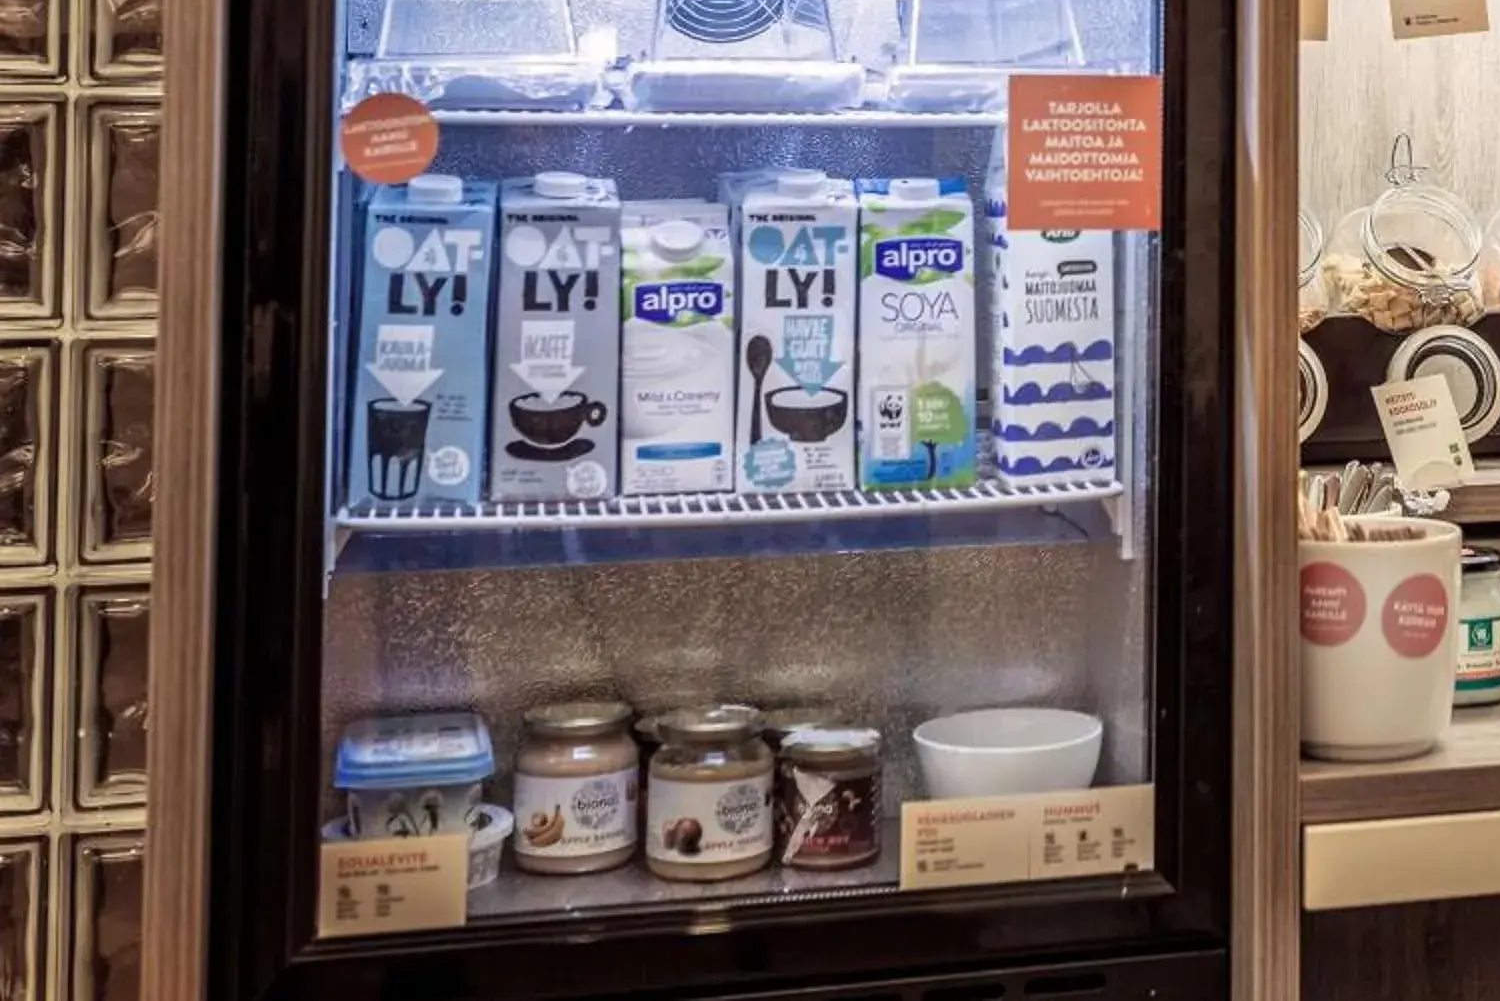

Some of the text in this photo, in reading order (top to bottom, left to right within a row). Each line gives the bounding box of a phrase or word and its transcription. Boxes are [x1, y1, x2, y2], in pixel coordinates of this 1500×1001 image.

[1048, 102, 1123, 116] TARJOLLA
[1021, 118, 1147, 132] LAKTOOSITONTA
[1044, 135, 1125, 149] MAITOA JA
[1028, 152, 1140, 166] MAIDOTTOMIA
[881, 242, 957, 274] alpro
[387, 272, 468, 317] LY!
[523, 270, 600, 313] LY!
[765, 268, 836, 310] LY!
[1025, 278, 1097, 295] MAITOJUOMAA
[642, 286, 717, 317] alpro
[881, 290, 960, 323] SOYA
[1025, 297, 1099, 324] SUOMESTA
[637, 391, 664, 403] Mild
